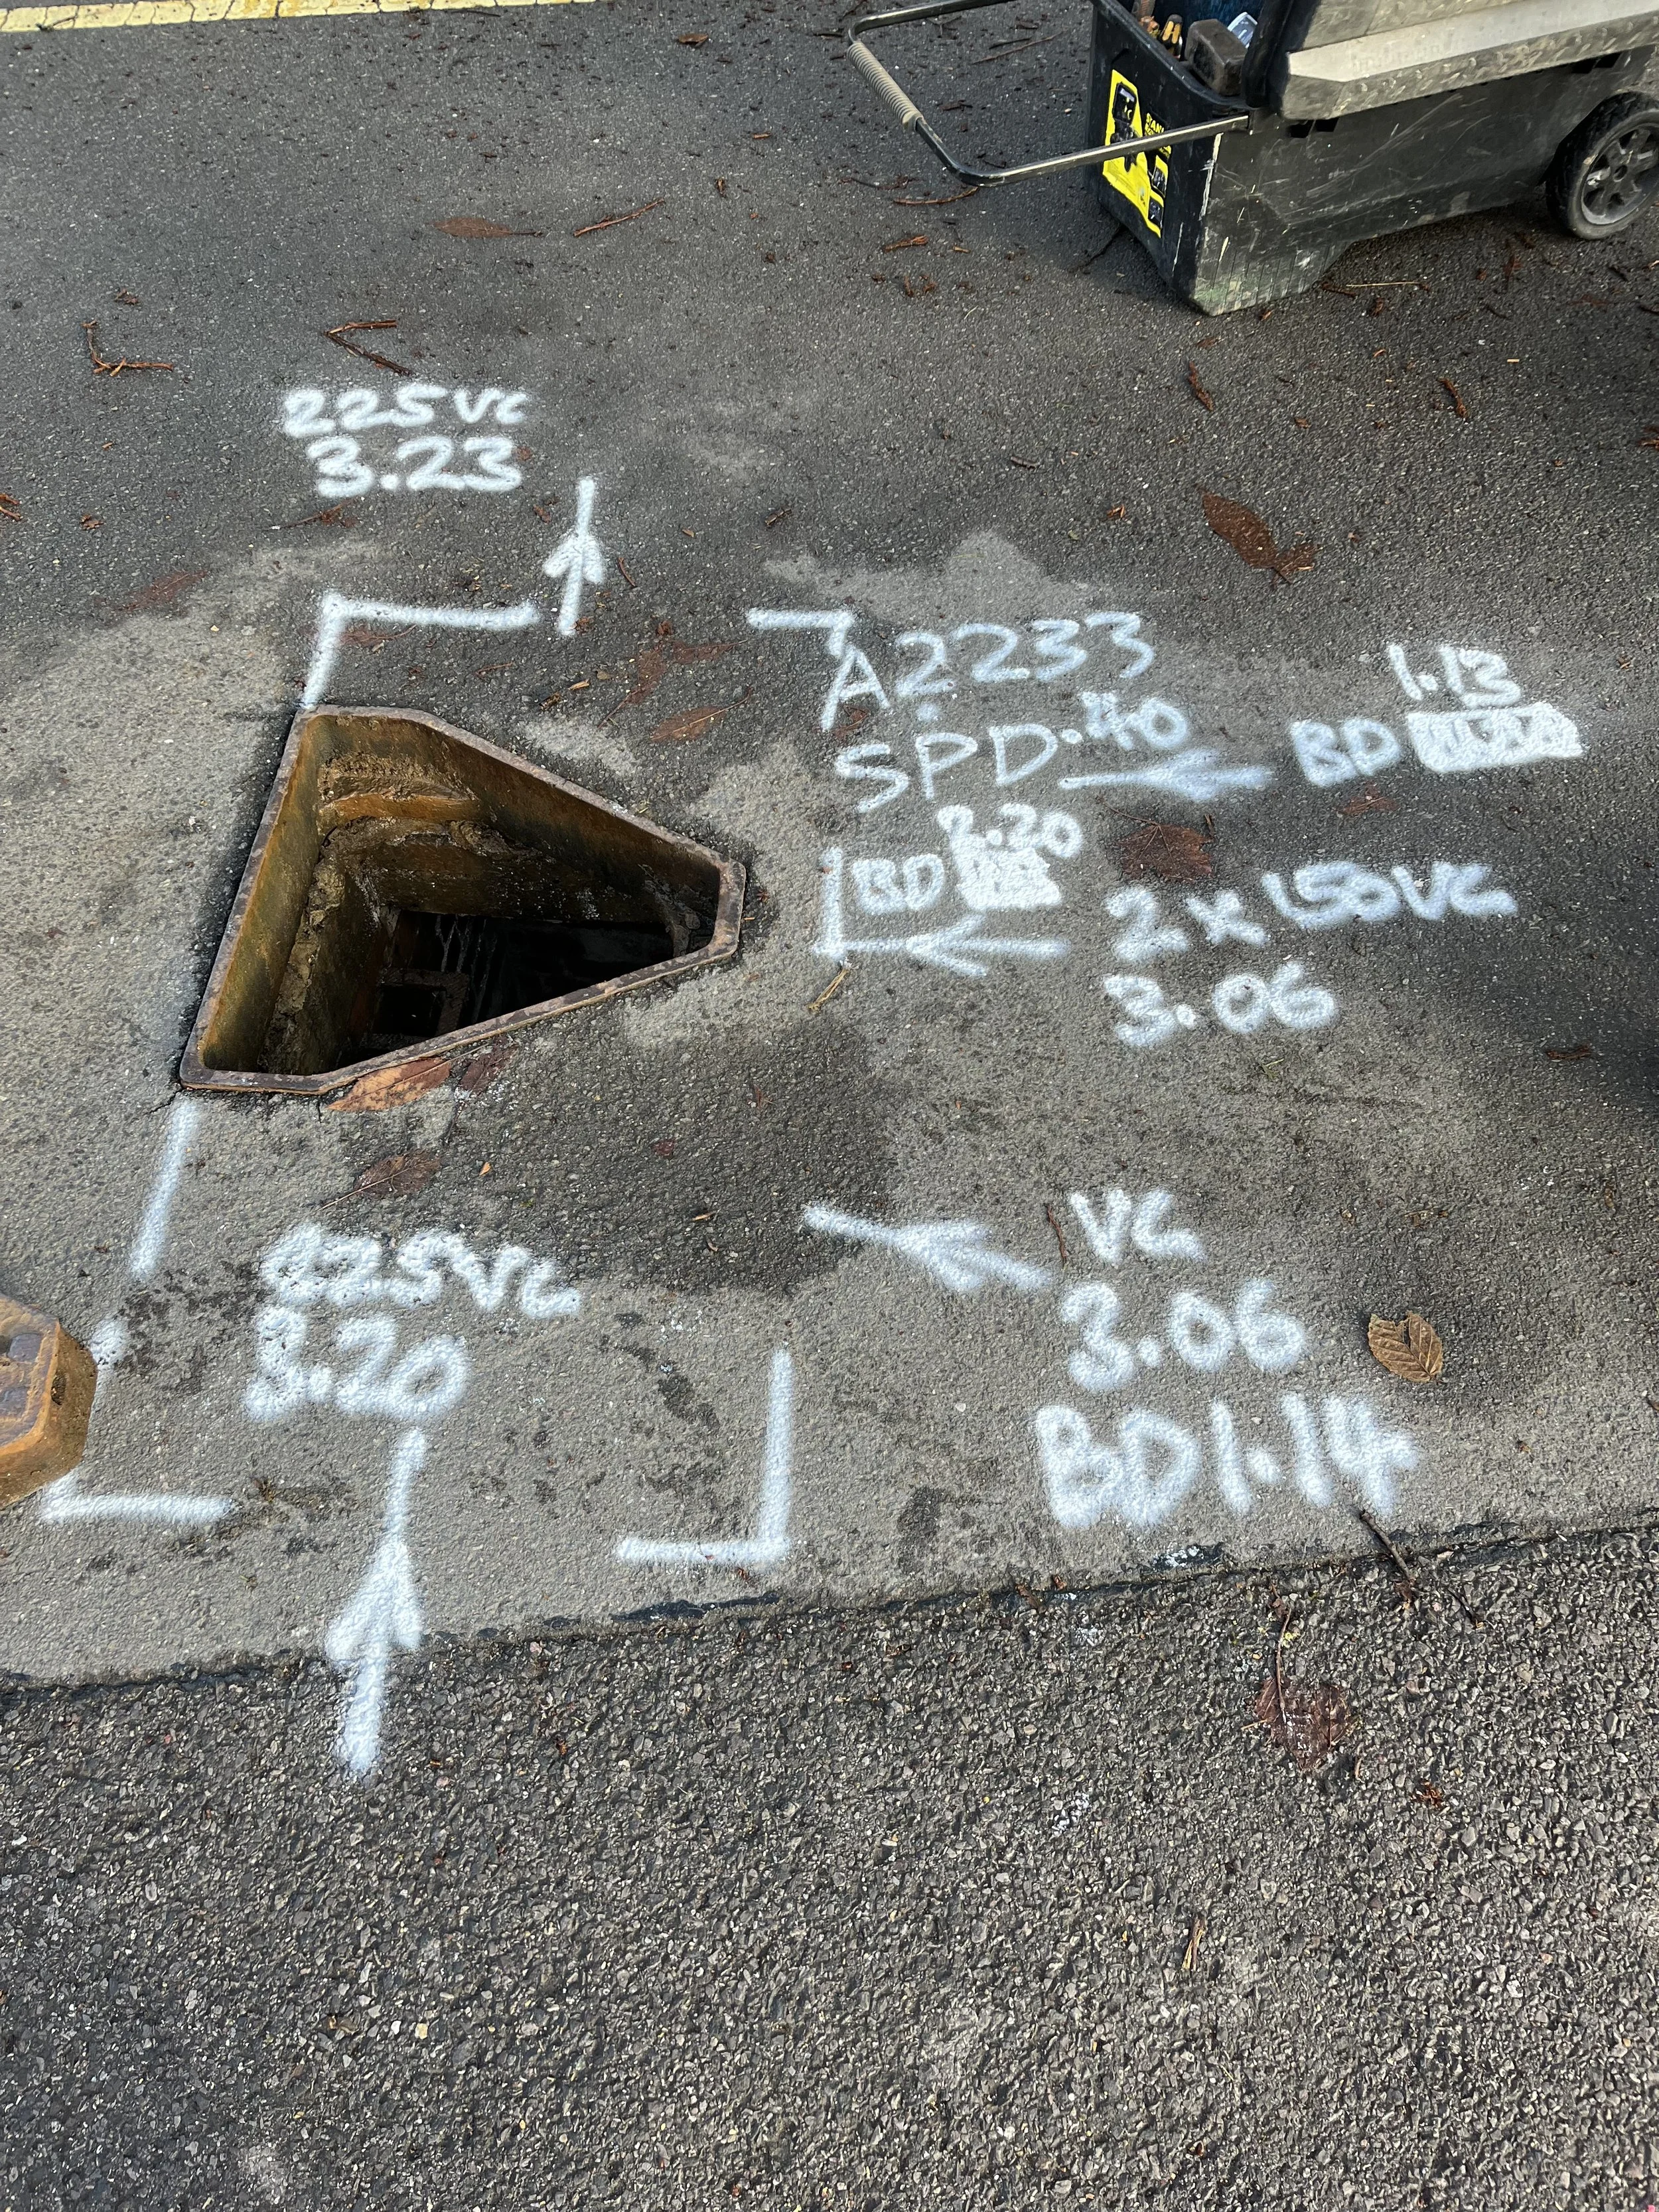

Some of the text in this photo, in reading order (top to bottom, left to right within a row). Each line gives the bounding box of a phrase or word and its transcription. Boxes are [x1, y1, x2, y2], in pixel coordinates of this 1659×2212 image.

[307, 435, 522, 498] 3.23
[1387, 644, 1522, 709] 1.13
[1289, 718, 1402, 787] BD
[1103, 887, 1189, 964] 2
[1102, 962, 1338, 1047] 3.06
[1068, 1188, 1206, 1264] VC
[1060, 1278, 1307, 1392] 3.06
